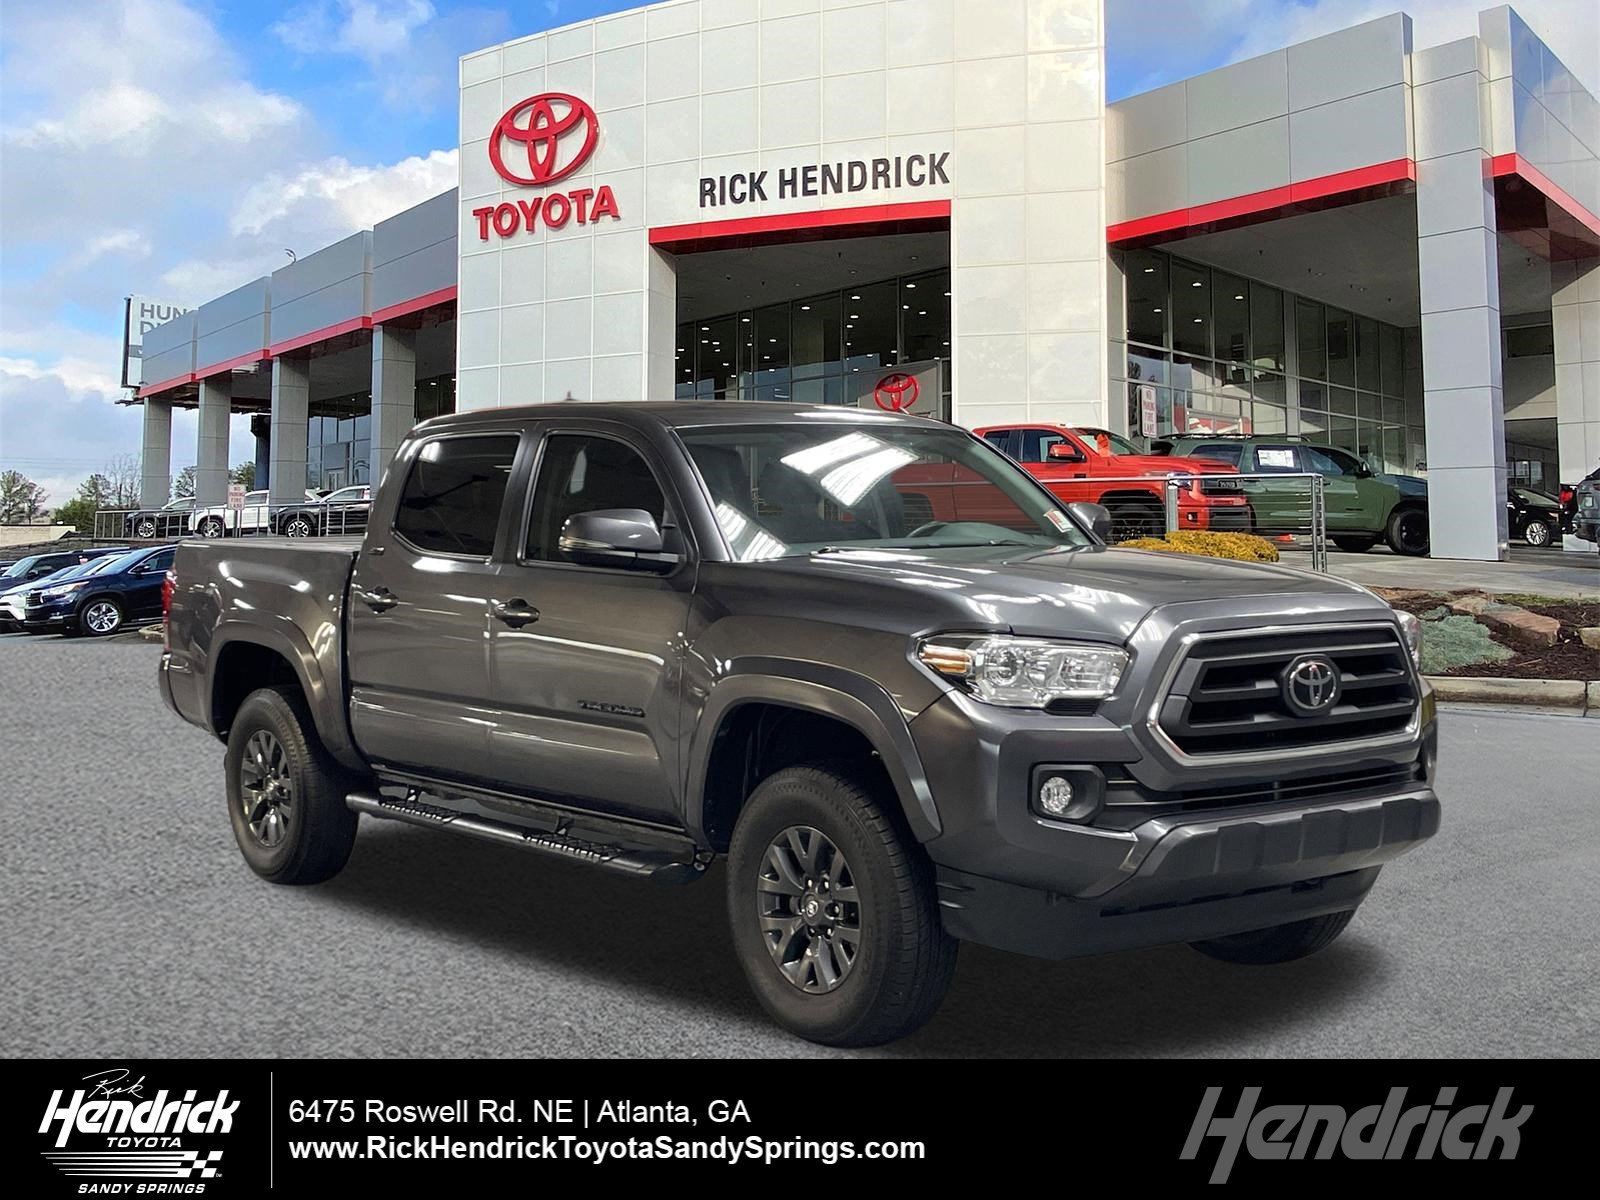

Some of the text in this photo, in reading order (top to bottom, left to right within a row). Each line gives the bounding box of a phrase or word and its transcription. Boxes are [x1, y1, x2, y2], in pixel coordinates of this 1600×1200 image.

[699, 152, 950, 208] RICK HENDRICK
[472, 185, 620, 240] TOYOTA
